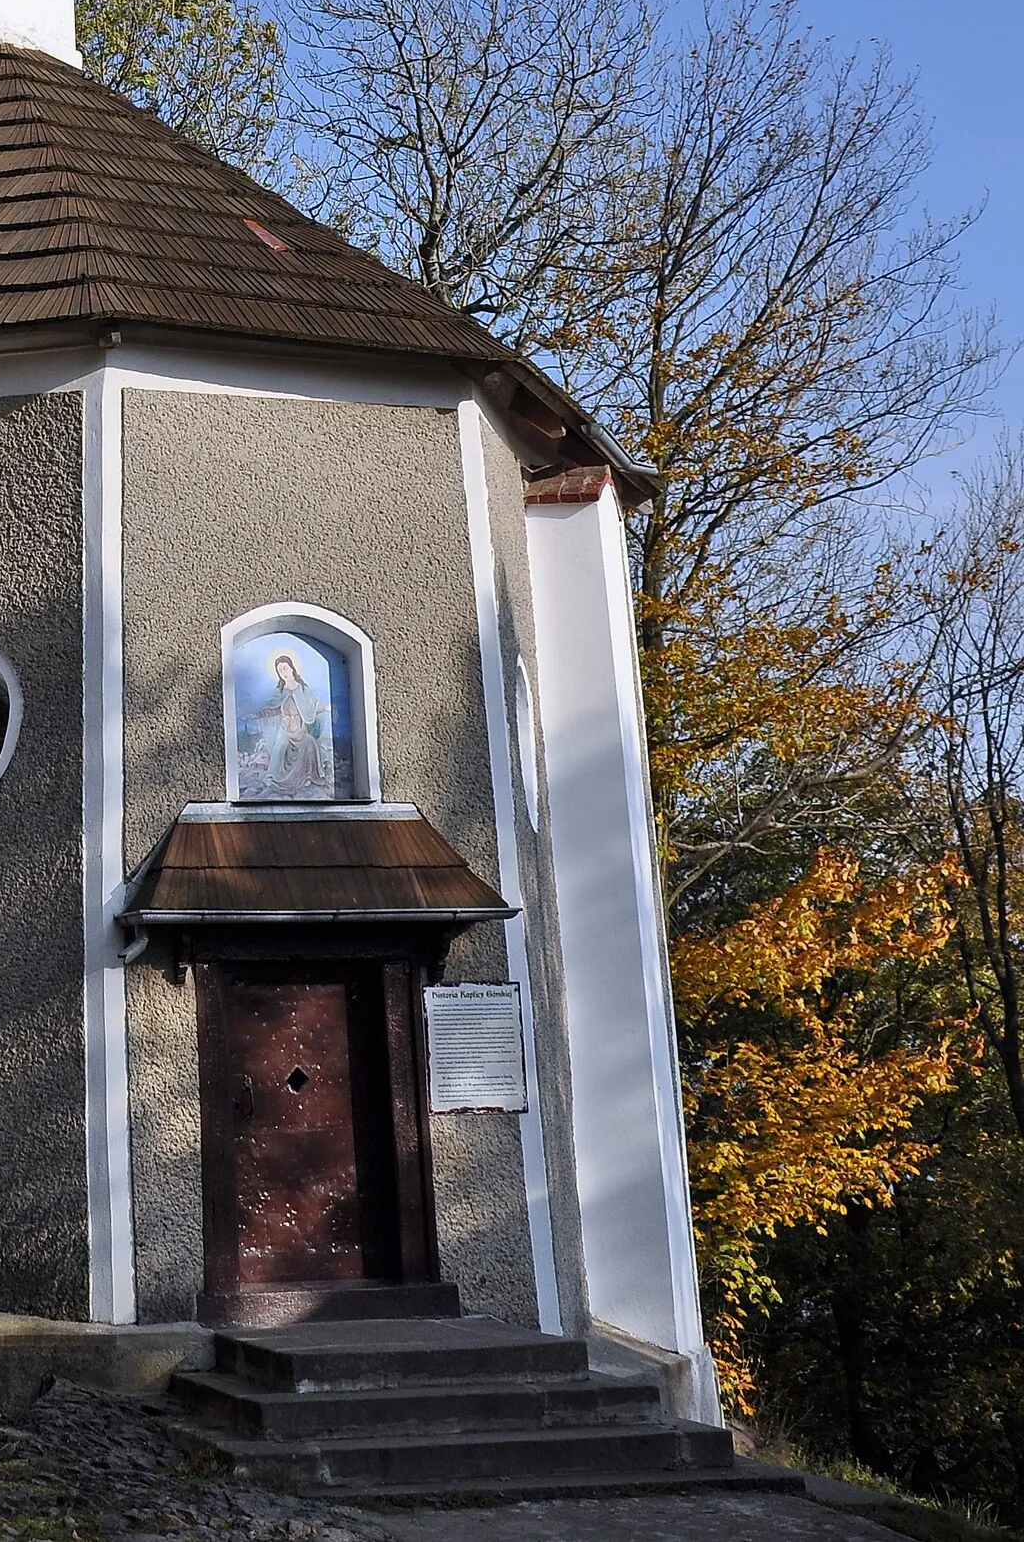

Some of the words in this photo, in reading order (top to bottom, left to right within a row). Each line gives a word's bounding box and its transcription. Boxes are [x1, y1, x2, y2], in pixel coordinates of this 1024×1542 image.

[431, 991, 458, 999] Historia
[460, 990, 484, 1000] Kaplicy
[486, 989, 513, 999] Górskiej
